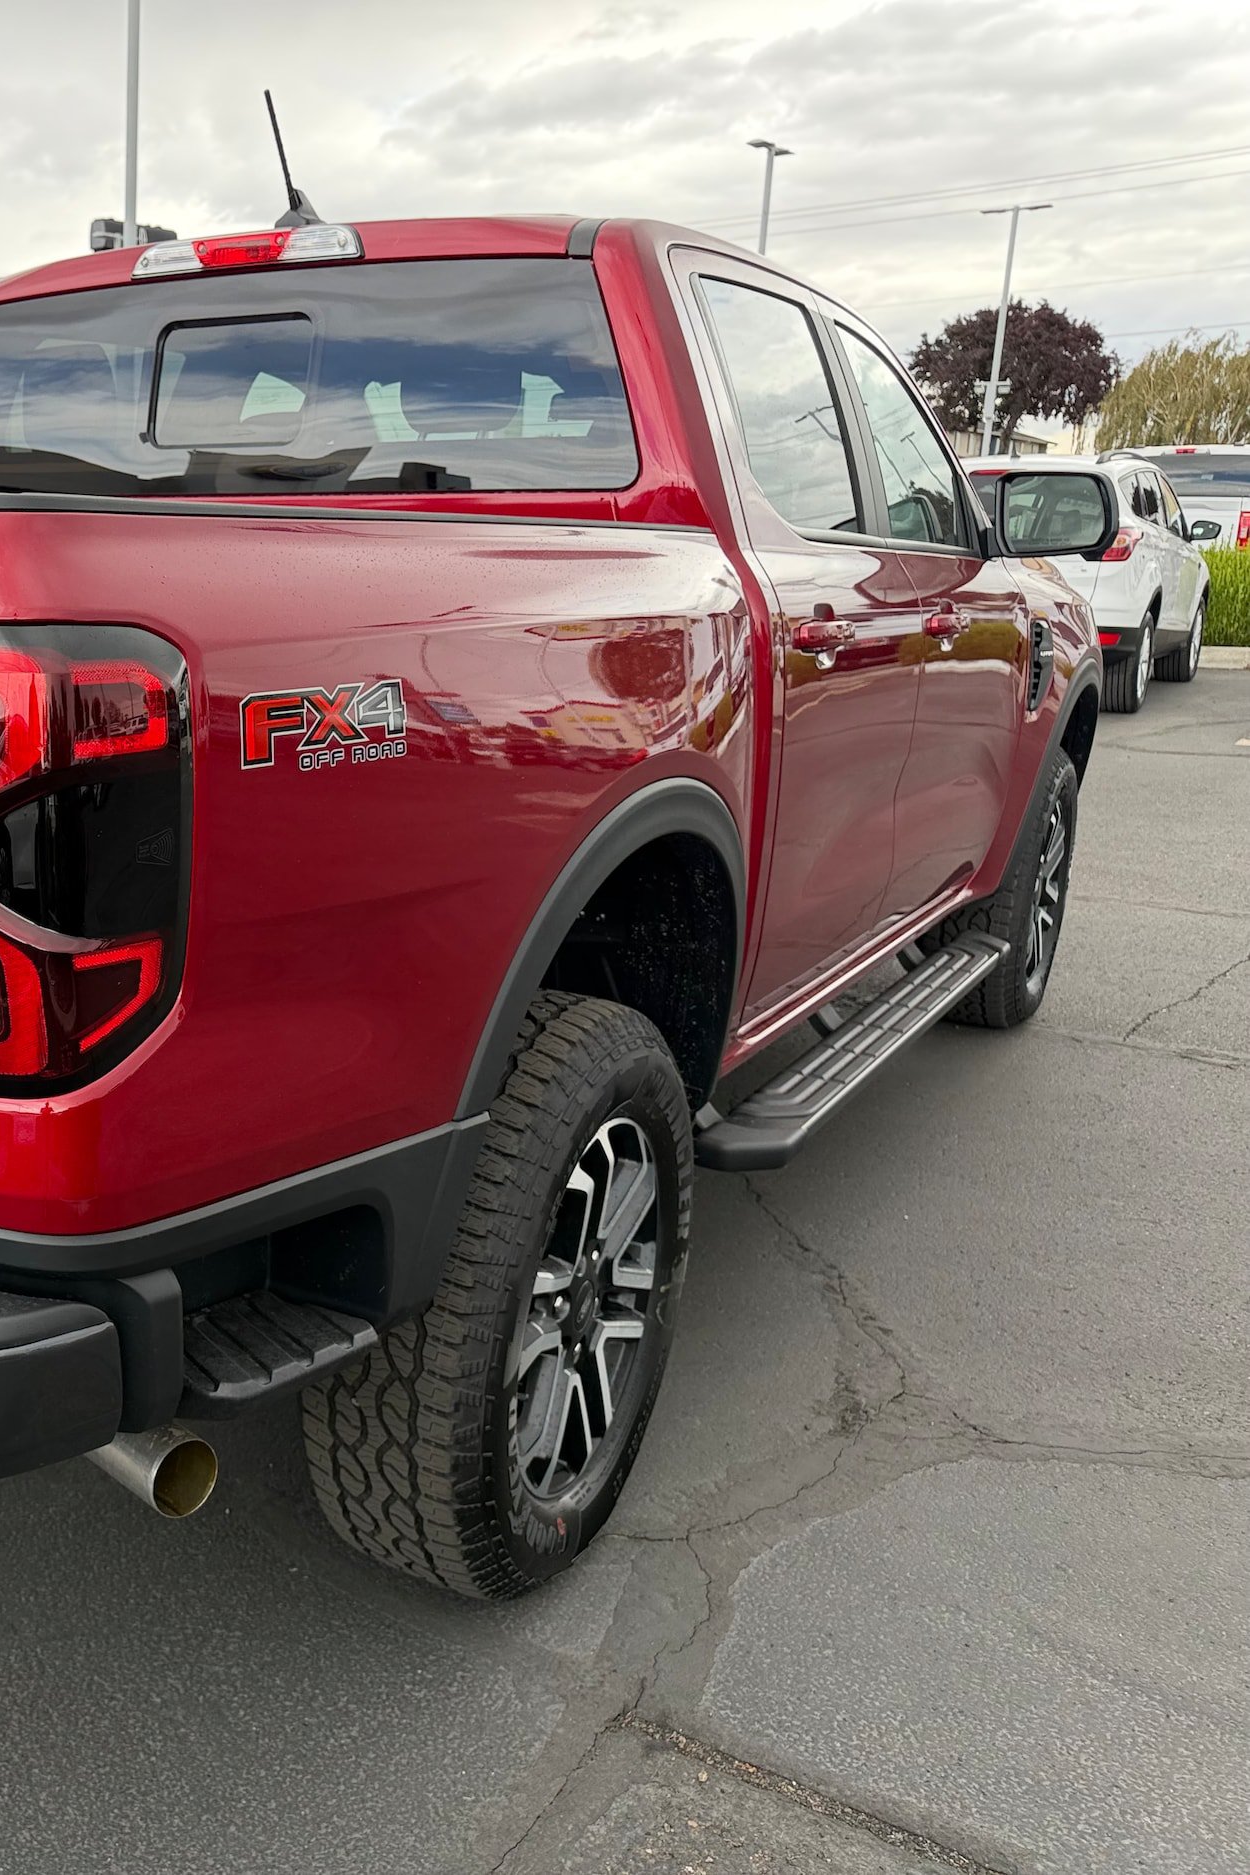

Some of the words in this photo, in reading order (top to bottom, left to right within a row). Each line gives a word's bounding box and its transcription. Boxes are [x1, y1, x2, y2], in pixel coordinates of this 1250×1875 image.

[239, 679, 407, 770] FX4
[299, 748, 345, 771] OFF
[352, 740, 407, 764] ROAD
